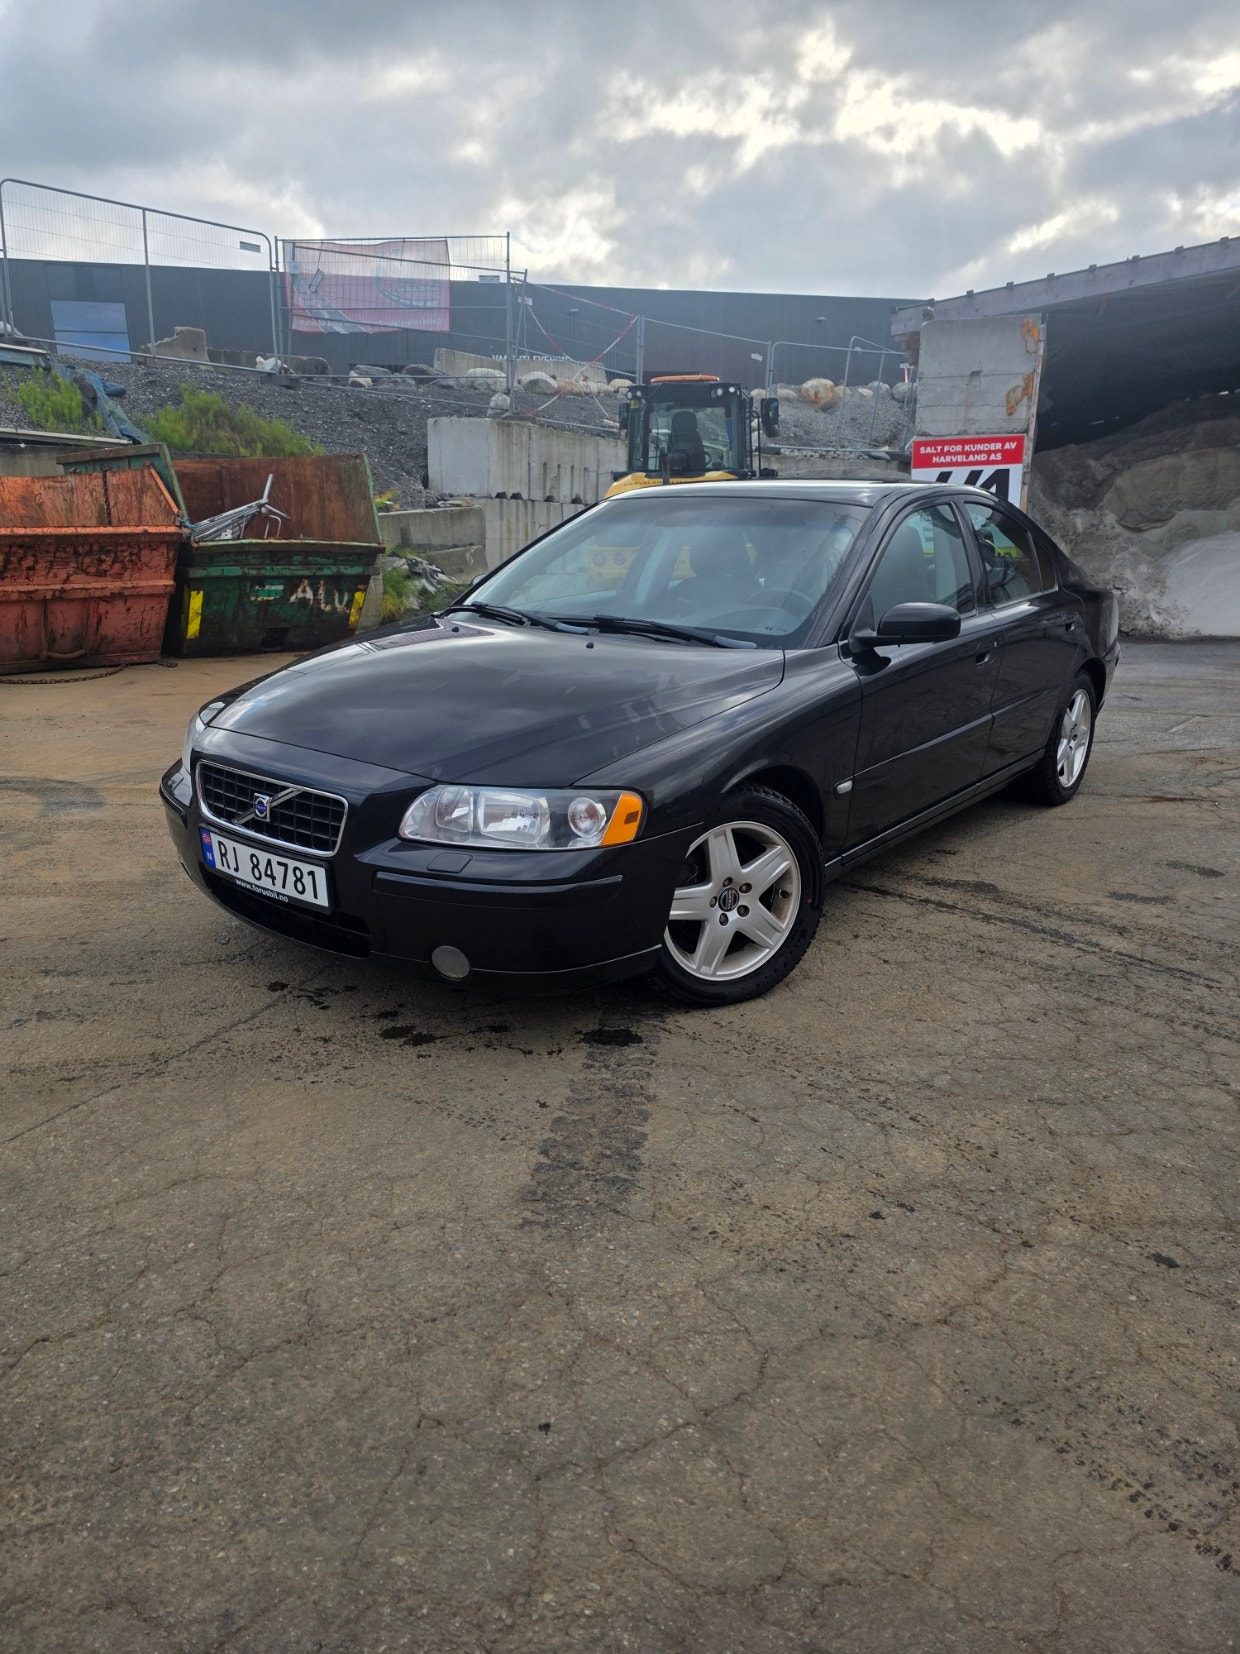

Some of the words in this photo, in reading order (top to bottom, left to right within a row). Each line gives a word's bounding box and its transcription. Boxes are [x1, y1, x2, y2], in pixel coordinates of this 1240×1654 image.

[920, 446, 942, 454] SALT
[943, 444, 962, 452] FOR
[964, 442, 1002, 452] KUNDER
[1003, 441, 1017, 450] AV
[932, 453, 987, 464] HARVELAND
[989, 453, 1002, 461] AS
[206, 852, 213, 861] N
[217, 840, 240, 873] RJ
[249, 852, 318, 900] 84781
[234, 878, 290, 903] www.forusbil.no
